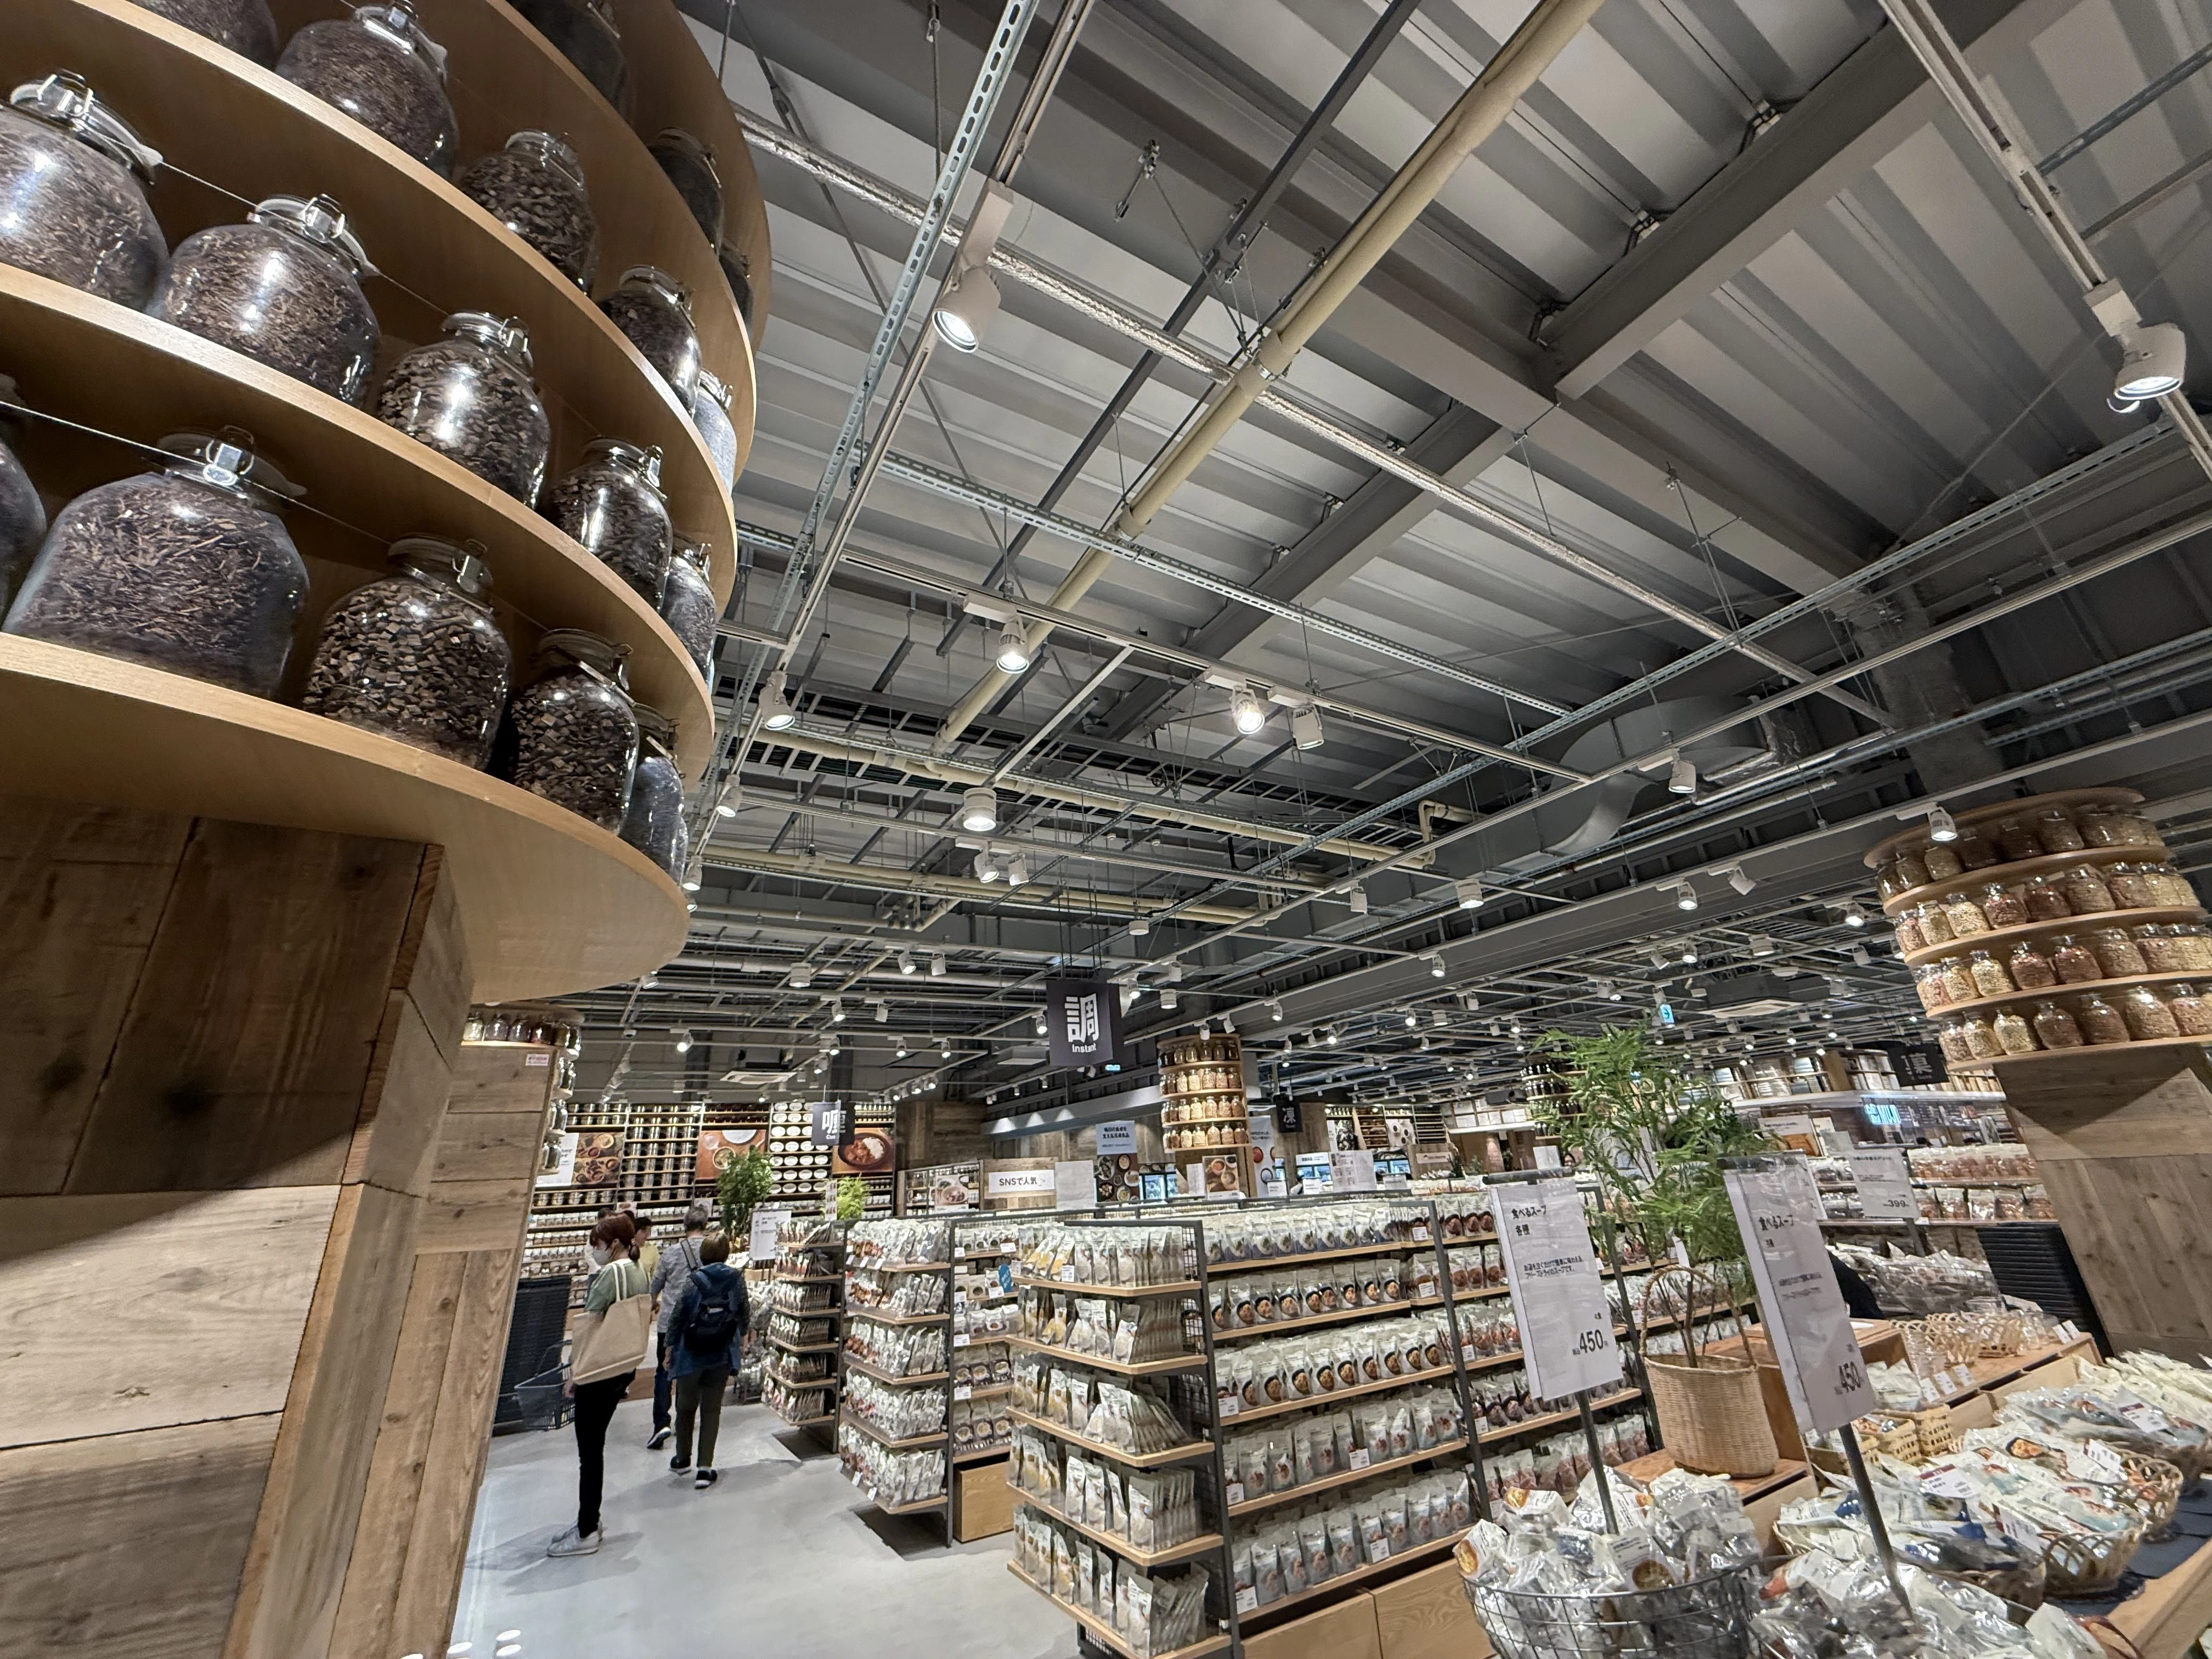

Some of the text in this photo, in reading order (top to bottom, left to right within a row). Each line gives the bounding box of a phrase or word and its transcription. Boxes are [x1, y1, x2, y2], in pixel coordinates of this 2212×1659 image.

[1065, 993, 1099, 1043] 調
[1072, 1043, 1097, 1053] Instant
[999, 1177, 1037, 1186] SNSで人気
[1511, 1205, 1546, 1219] 食べるスープ
[1580, 1329, 1604, 1353] 450
